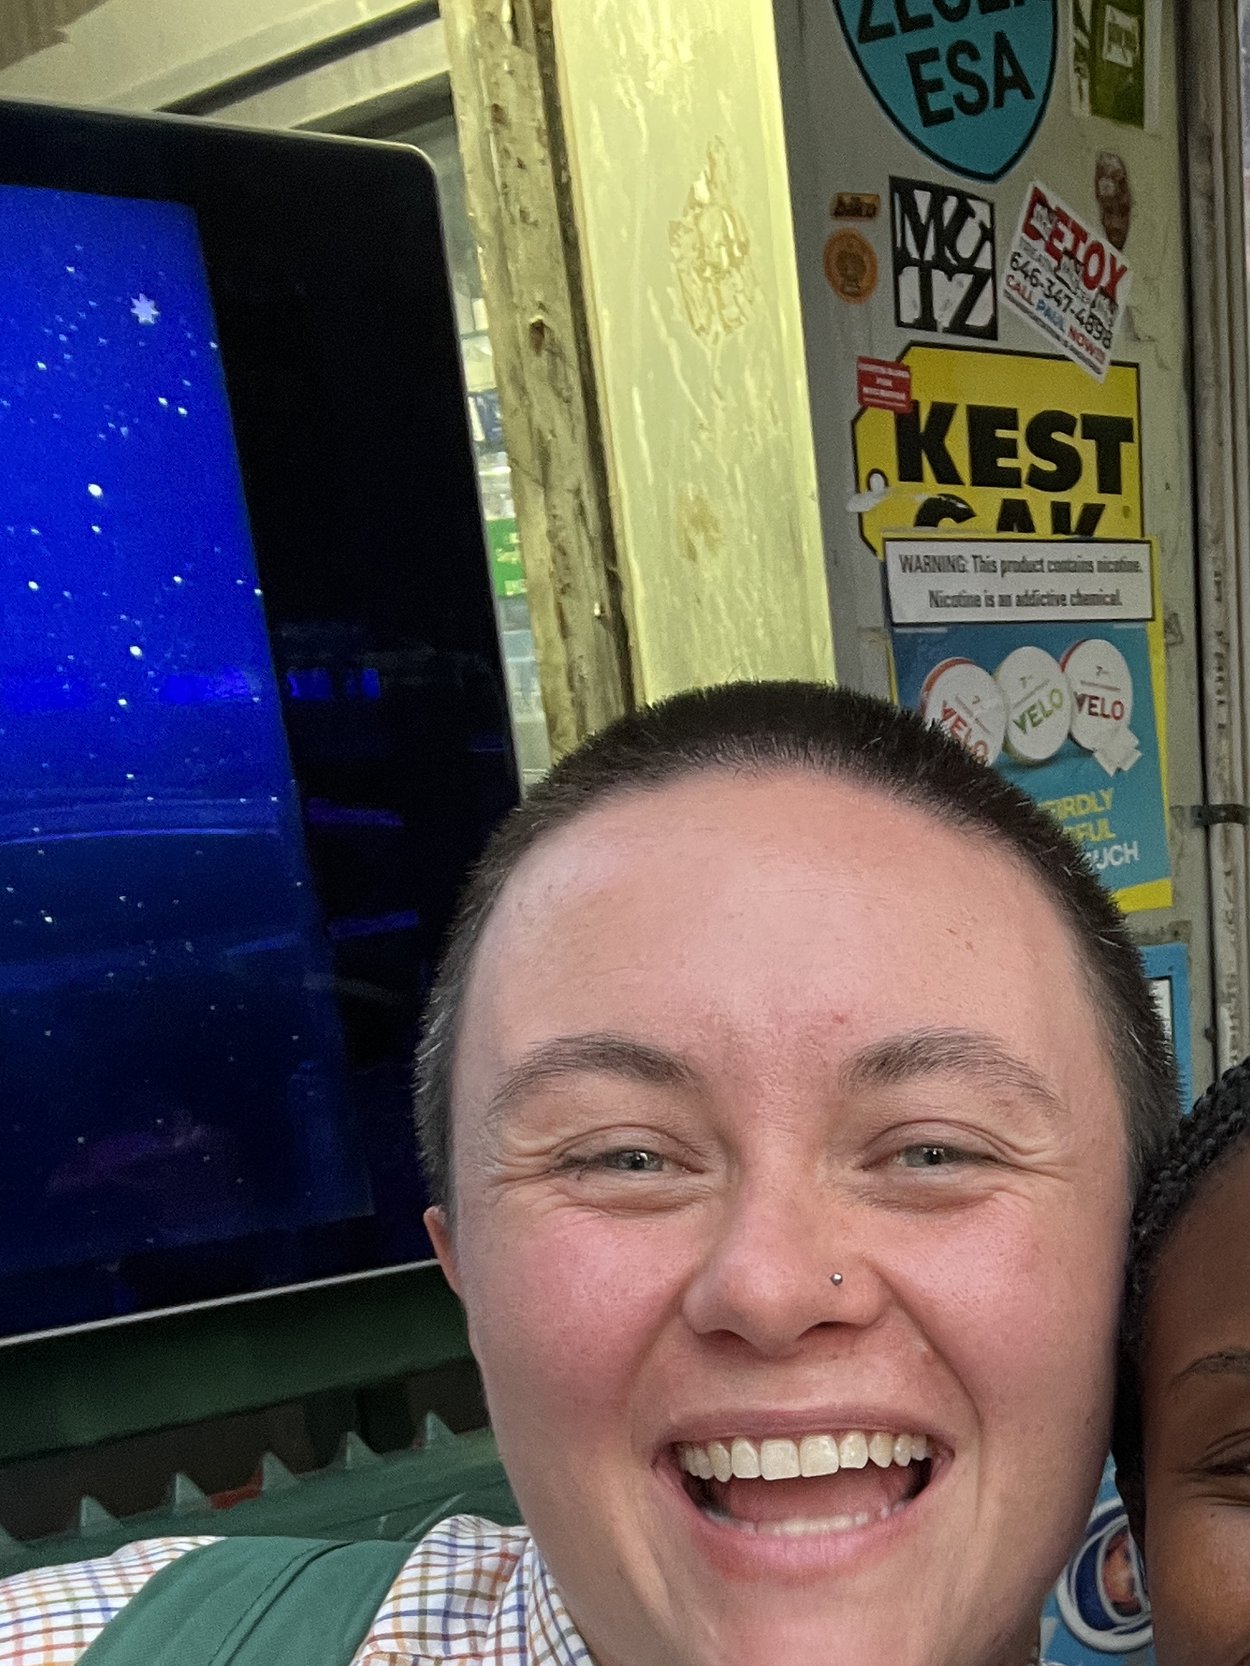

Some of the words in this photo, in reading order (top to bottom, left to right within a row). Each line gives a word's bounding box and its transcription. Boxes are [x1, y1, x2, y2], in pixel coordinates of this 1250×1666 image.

[905, 30, 1035, 128] ESA
[896, 400, 1135, 494] KEST
[972, 554, 997, 573] This
[1000, 555, 1044, 577] product
[1048, 555, 1094, 573] contains
[928, 589, 982, 608] Nicotine
[984, 589, 995, 607] is
[998, 593, 1012, 607] an
[1015, 588, 1067, 607] addictive
[1012, 688, 1064, 736] VELO
[1073, 691, 1125, 721] VELO
